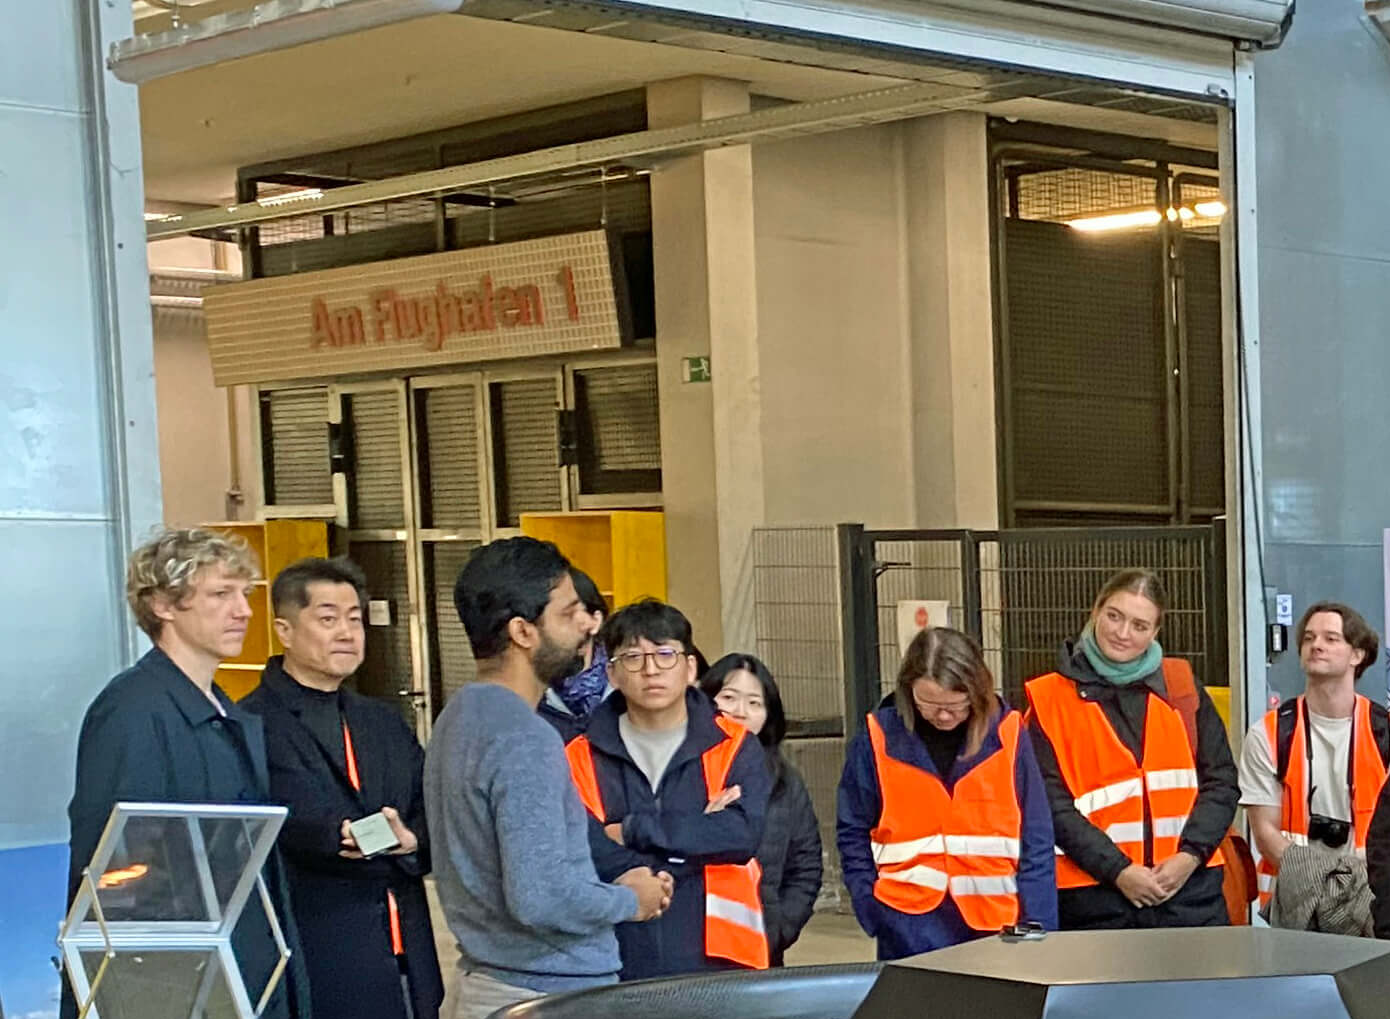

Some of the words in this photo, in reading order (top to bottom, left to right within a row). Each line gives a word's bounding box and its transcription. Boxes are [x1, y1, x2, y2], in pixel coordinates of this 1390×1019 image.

[310, 296, 365, 349] Am
[371, 273, 545, 350] Flughafen
[556, 264, 580, 323] 1
